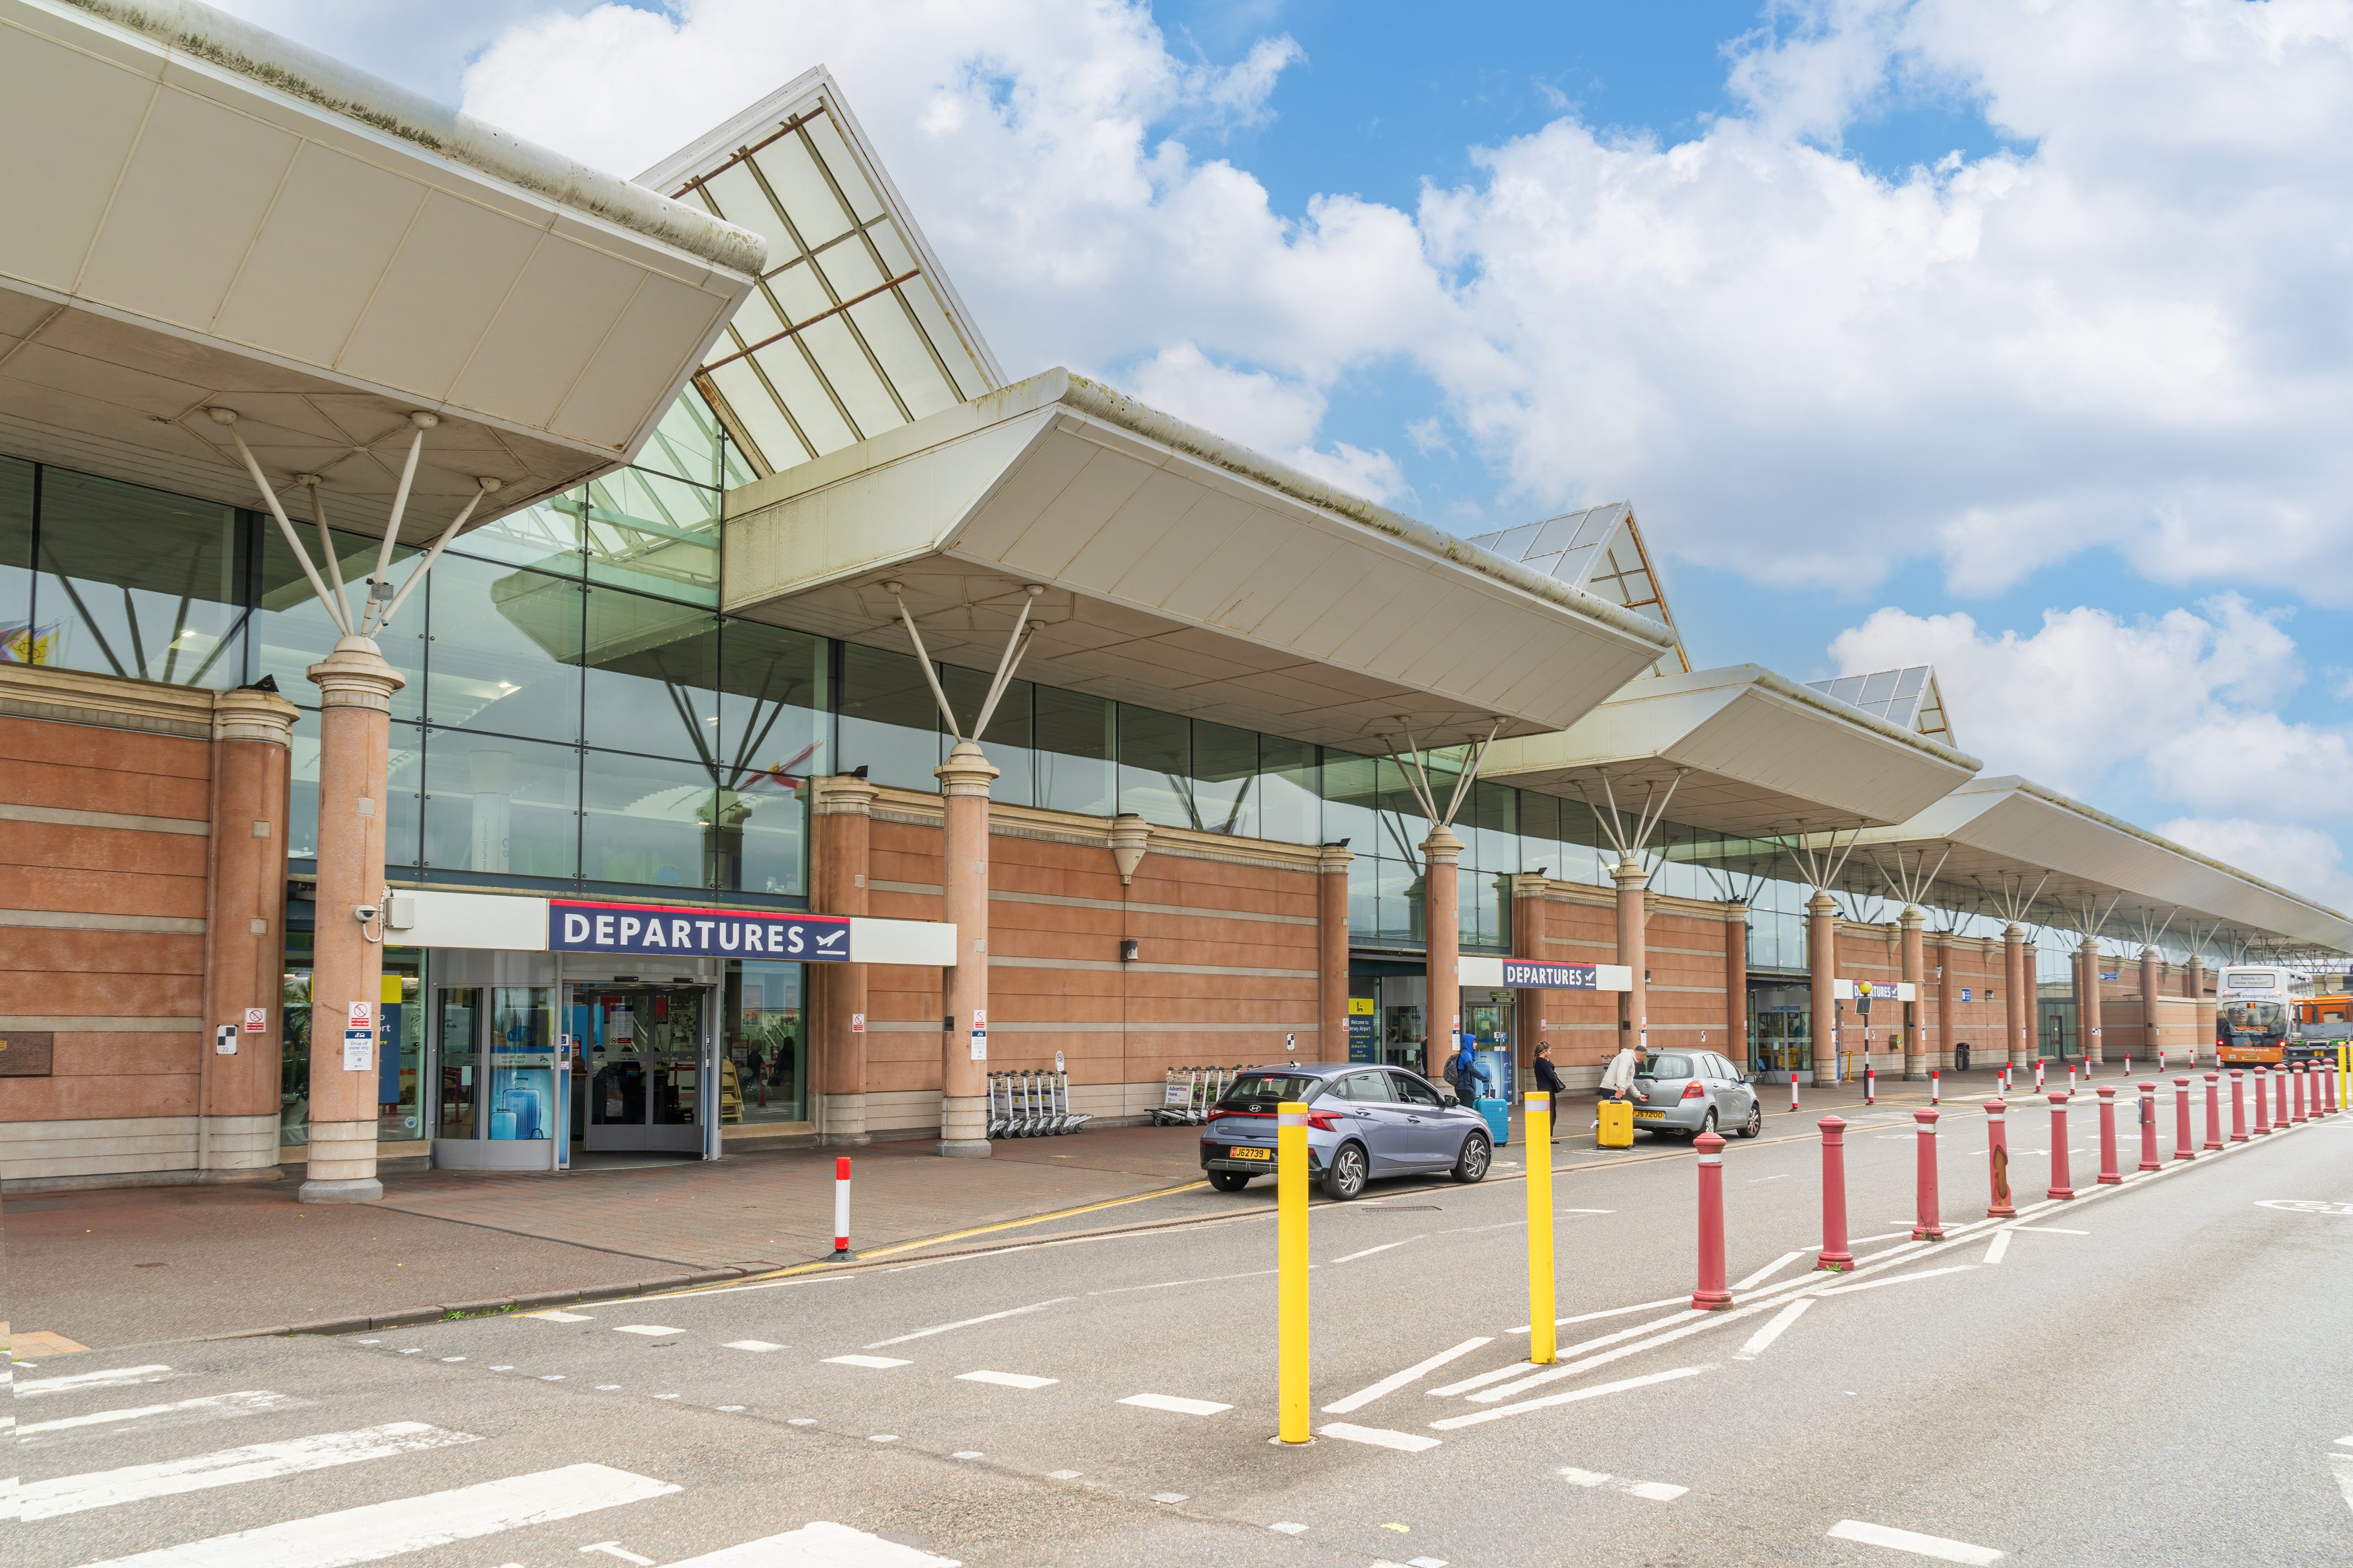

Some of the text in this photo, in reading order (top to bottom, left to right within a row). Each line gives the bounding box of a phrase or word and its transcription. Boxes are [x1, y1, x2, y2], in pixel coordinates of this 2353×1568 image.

[564, 913, 805, 953] DEPARTURES
[1507, 966, 1582, 985] DEPARTURES
[1236, 1148, 1264, 1158] J62739
